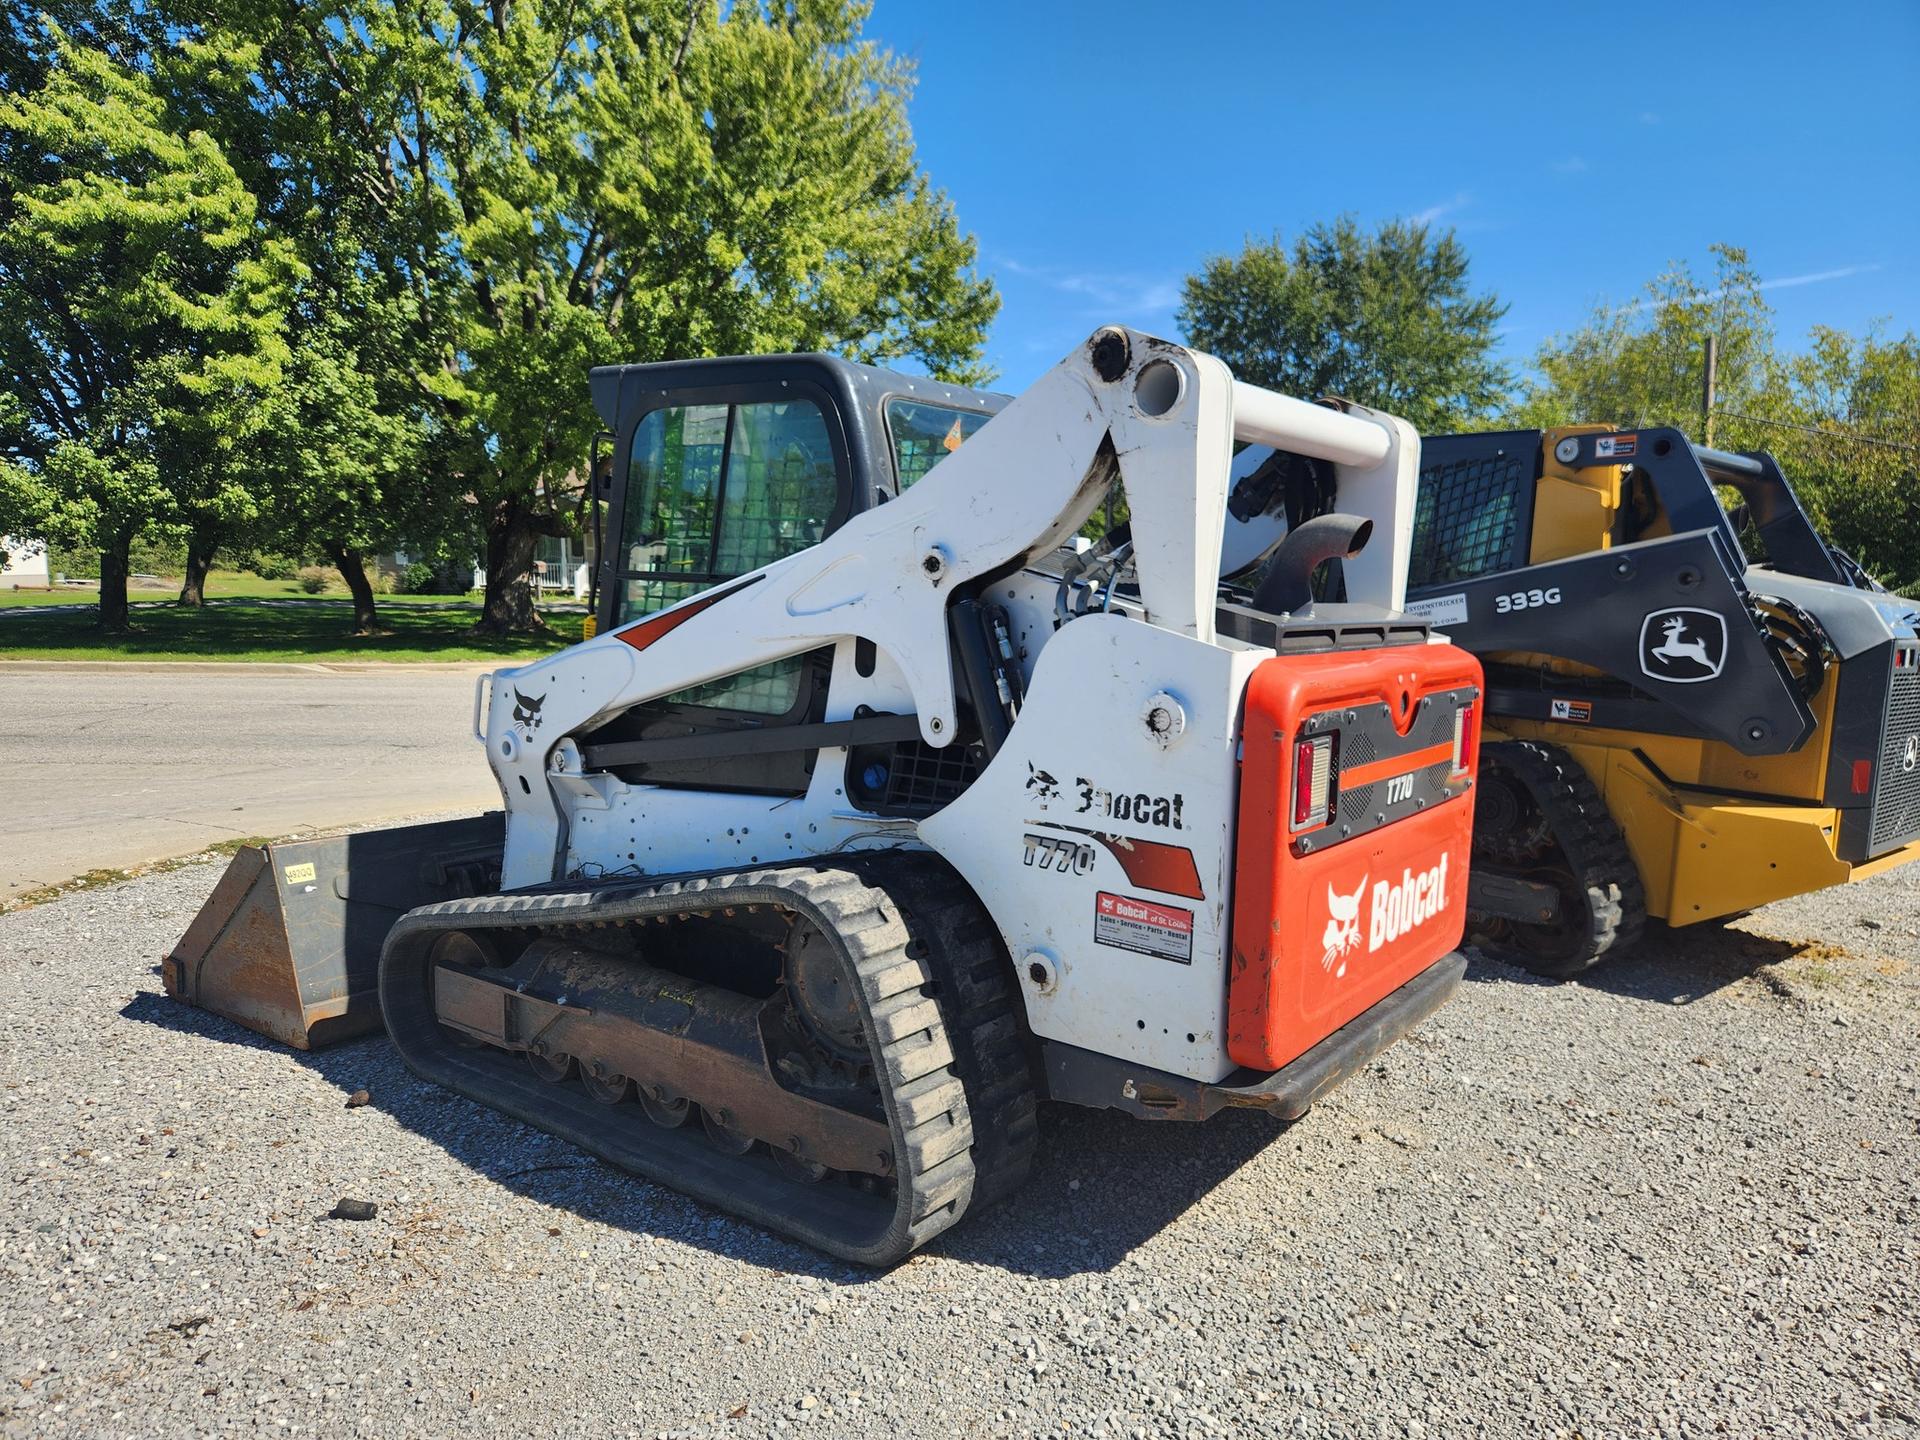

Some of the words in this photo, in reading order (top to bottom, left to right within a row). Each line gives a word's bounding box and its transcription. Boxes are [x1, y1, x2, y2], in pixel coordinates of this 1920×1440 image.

[1495, 587, 1561, 614] 333G
[1386, 773, 1415, 806] T770
[1024, 833, 1096, 876] T770
[1116, 902, 1148, 920] Bobcat
[1150, 915, 1158, 923] of
[1168, 919, 1187, 930] Louis
[1368, 851, 1449, 954] Bobcat
[1100, 915, 1116, 924] Sales
[1120, 919, 1142, 930] Service
[1147, 925, 1163, 935] Parts
[1167, 930, 1188, 940] Rental
